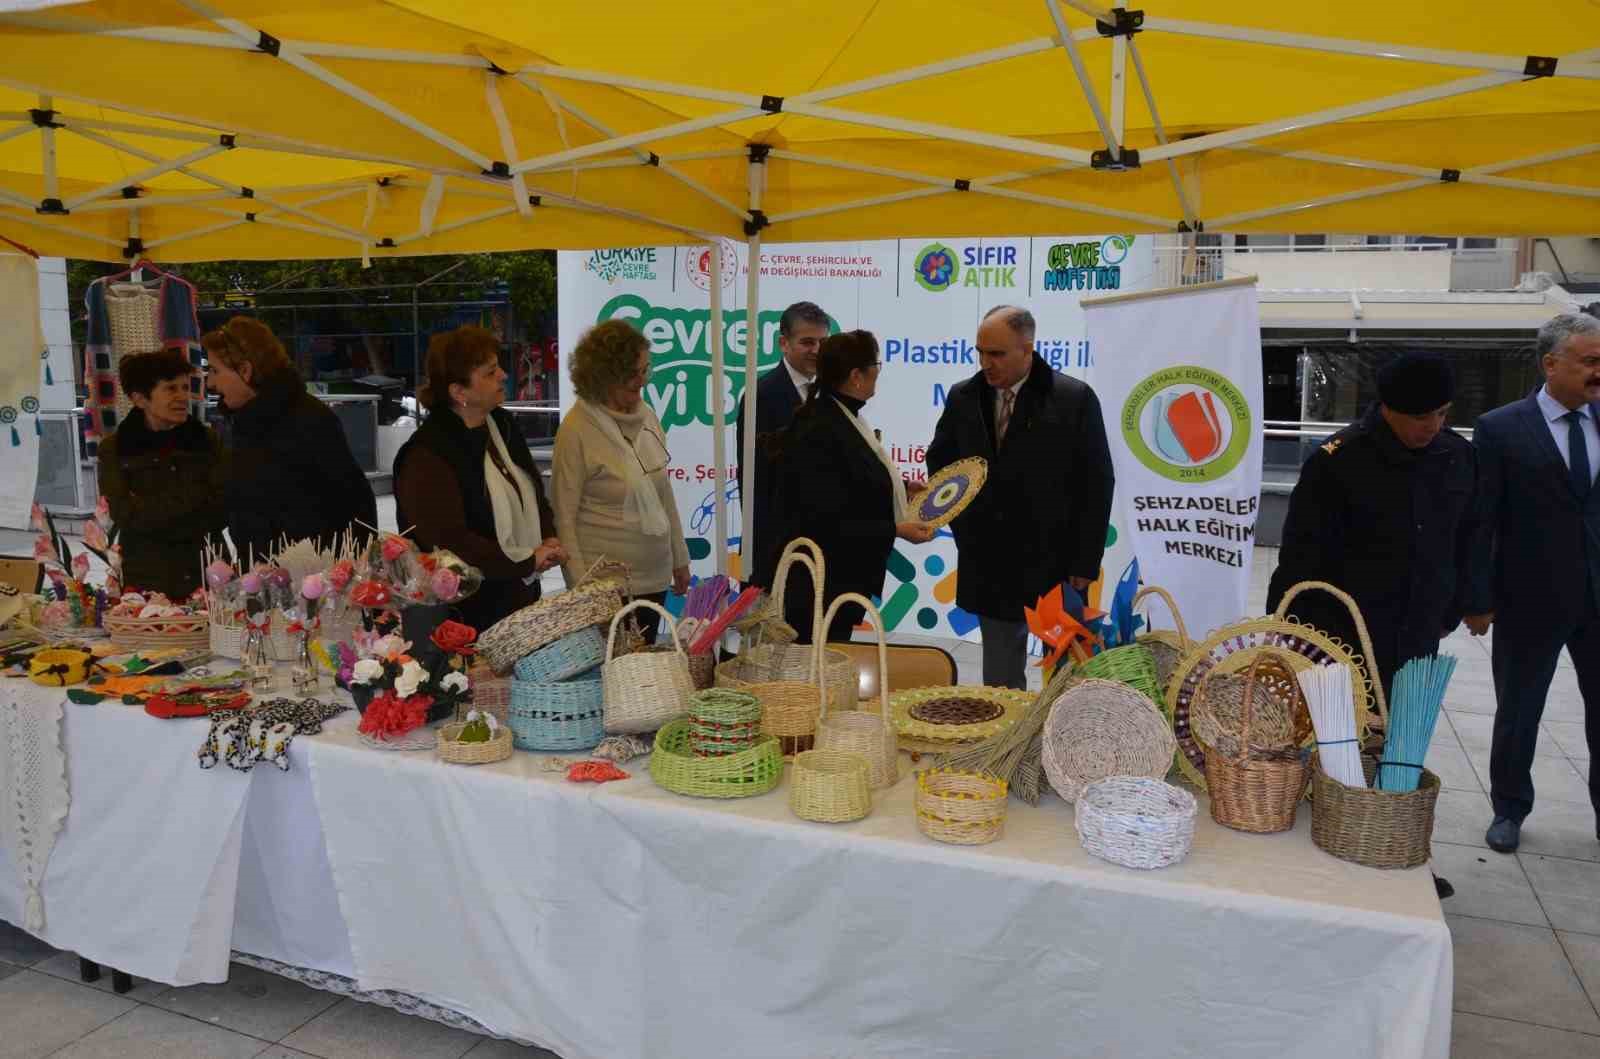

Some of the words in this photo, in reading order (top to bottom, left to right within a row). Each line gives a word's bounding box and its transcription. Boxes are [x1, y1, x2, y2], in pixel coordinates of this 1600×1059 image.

[771, 255, 803, 266] ÇEVRE,
[806, 254, 857, 266] ŞEHİRCİLİK
[860, 256, 873, 265] VE
[963, 246, 1017, 266] SIFIR
[1048, 242, 1101, 271] ÇEVRE
[963, 267, 1017, 289] ATIK
[885, 340, 975, 364] Plastik
[1157, 371, 1183, 382] HALK
[1180, 469, 1206, 478] 2014
[1133, 496, 1257, 516] ŞEHZADELER
[1137, 518, 1192, 533] HALK
[1195, 517, 1255, 542] EĞİTİM
[1164, 540, 1243, 568] MERKEZİ
